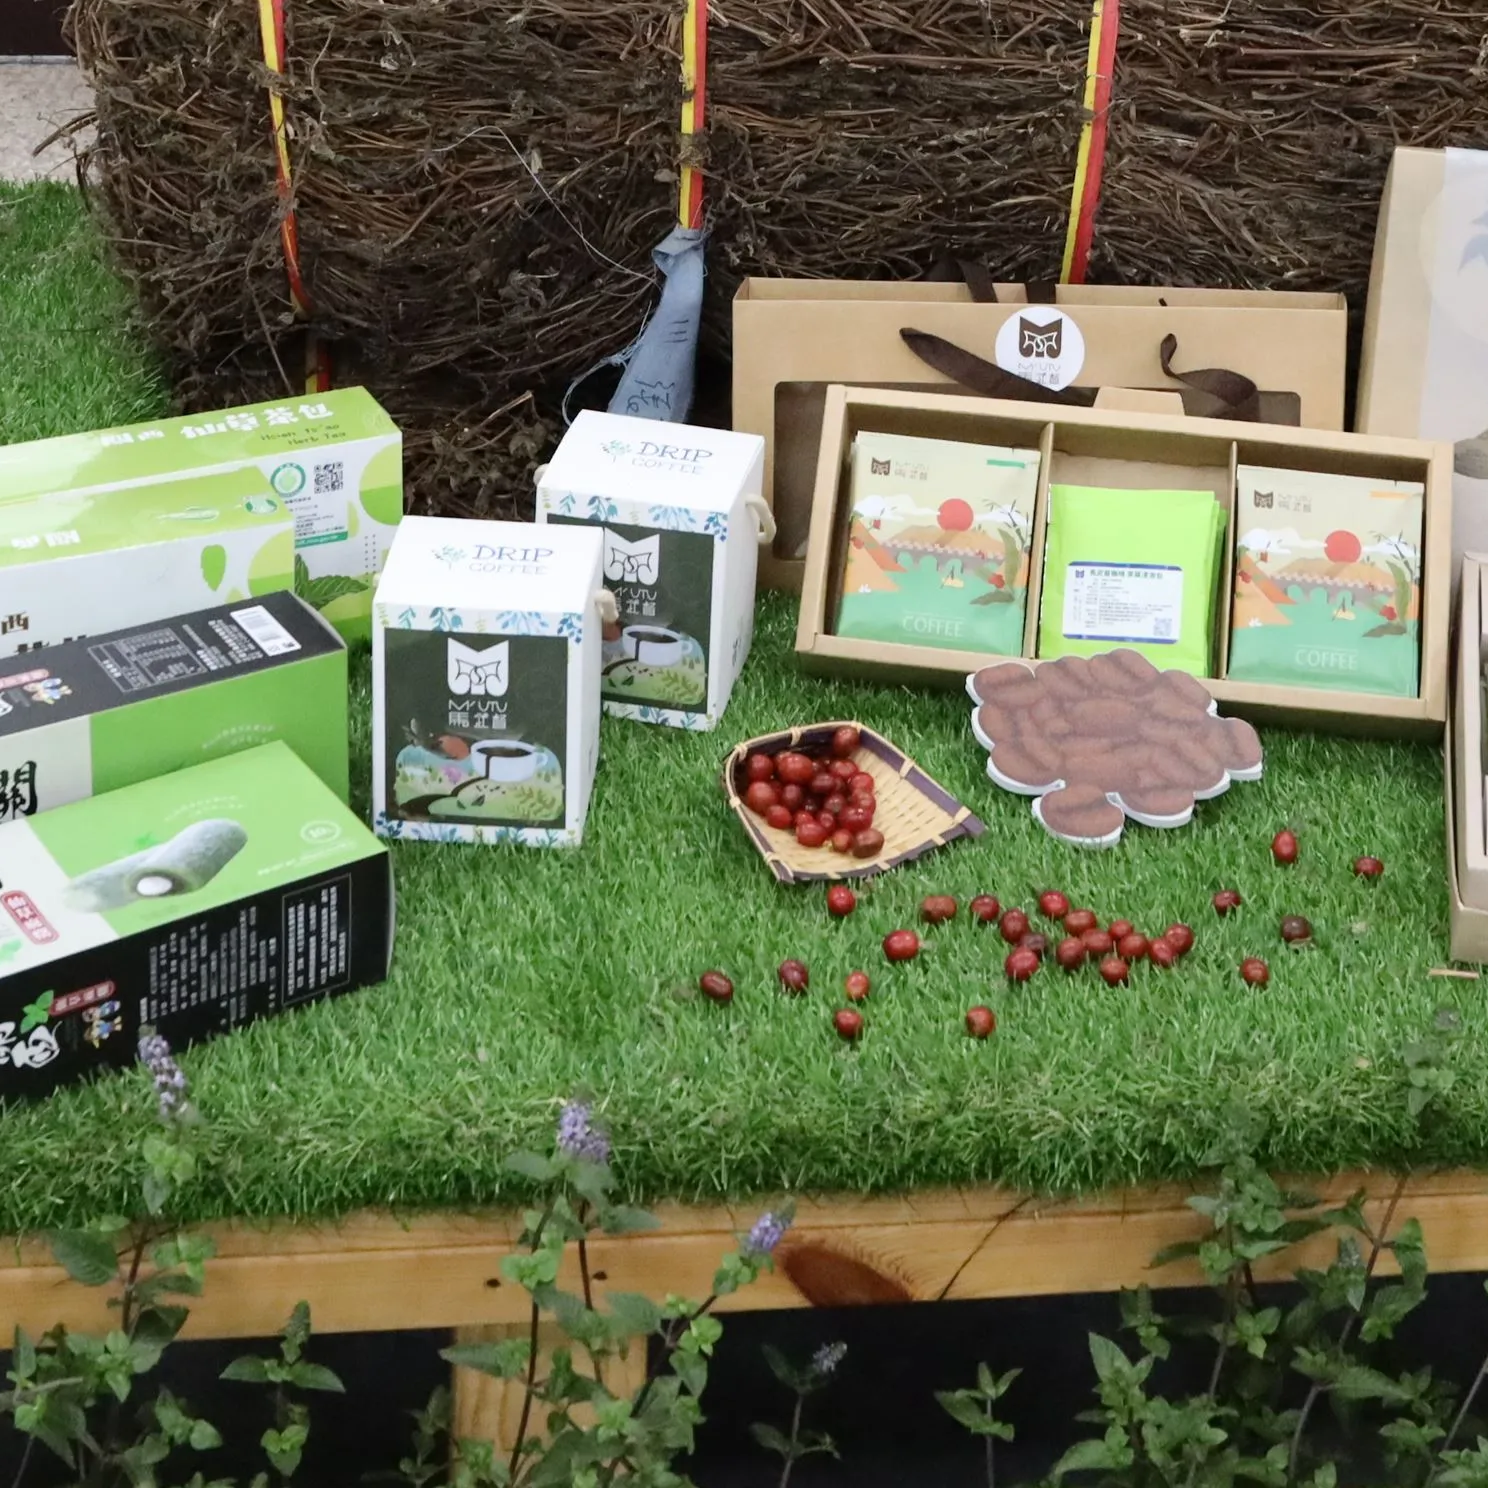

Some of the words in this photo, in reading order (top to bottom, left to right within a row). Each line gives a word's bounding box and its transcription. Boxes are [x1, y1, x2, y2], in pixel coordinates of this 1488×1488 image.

[180, 402, 333, 440] 仙草茶包
[635, 440, 714, 460] DRIP
[630, 459, 705, 475] COFFEE
[472, 544, 554, 563] DRIP
[469, 561, 551, 575] COFFEE
[901, 615, 966, 638] COFFEE
[1295, 647, 1359, 671] COFFEE
